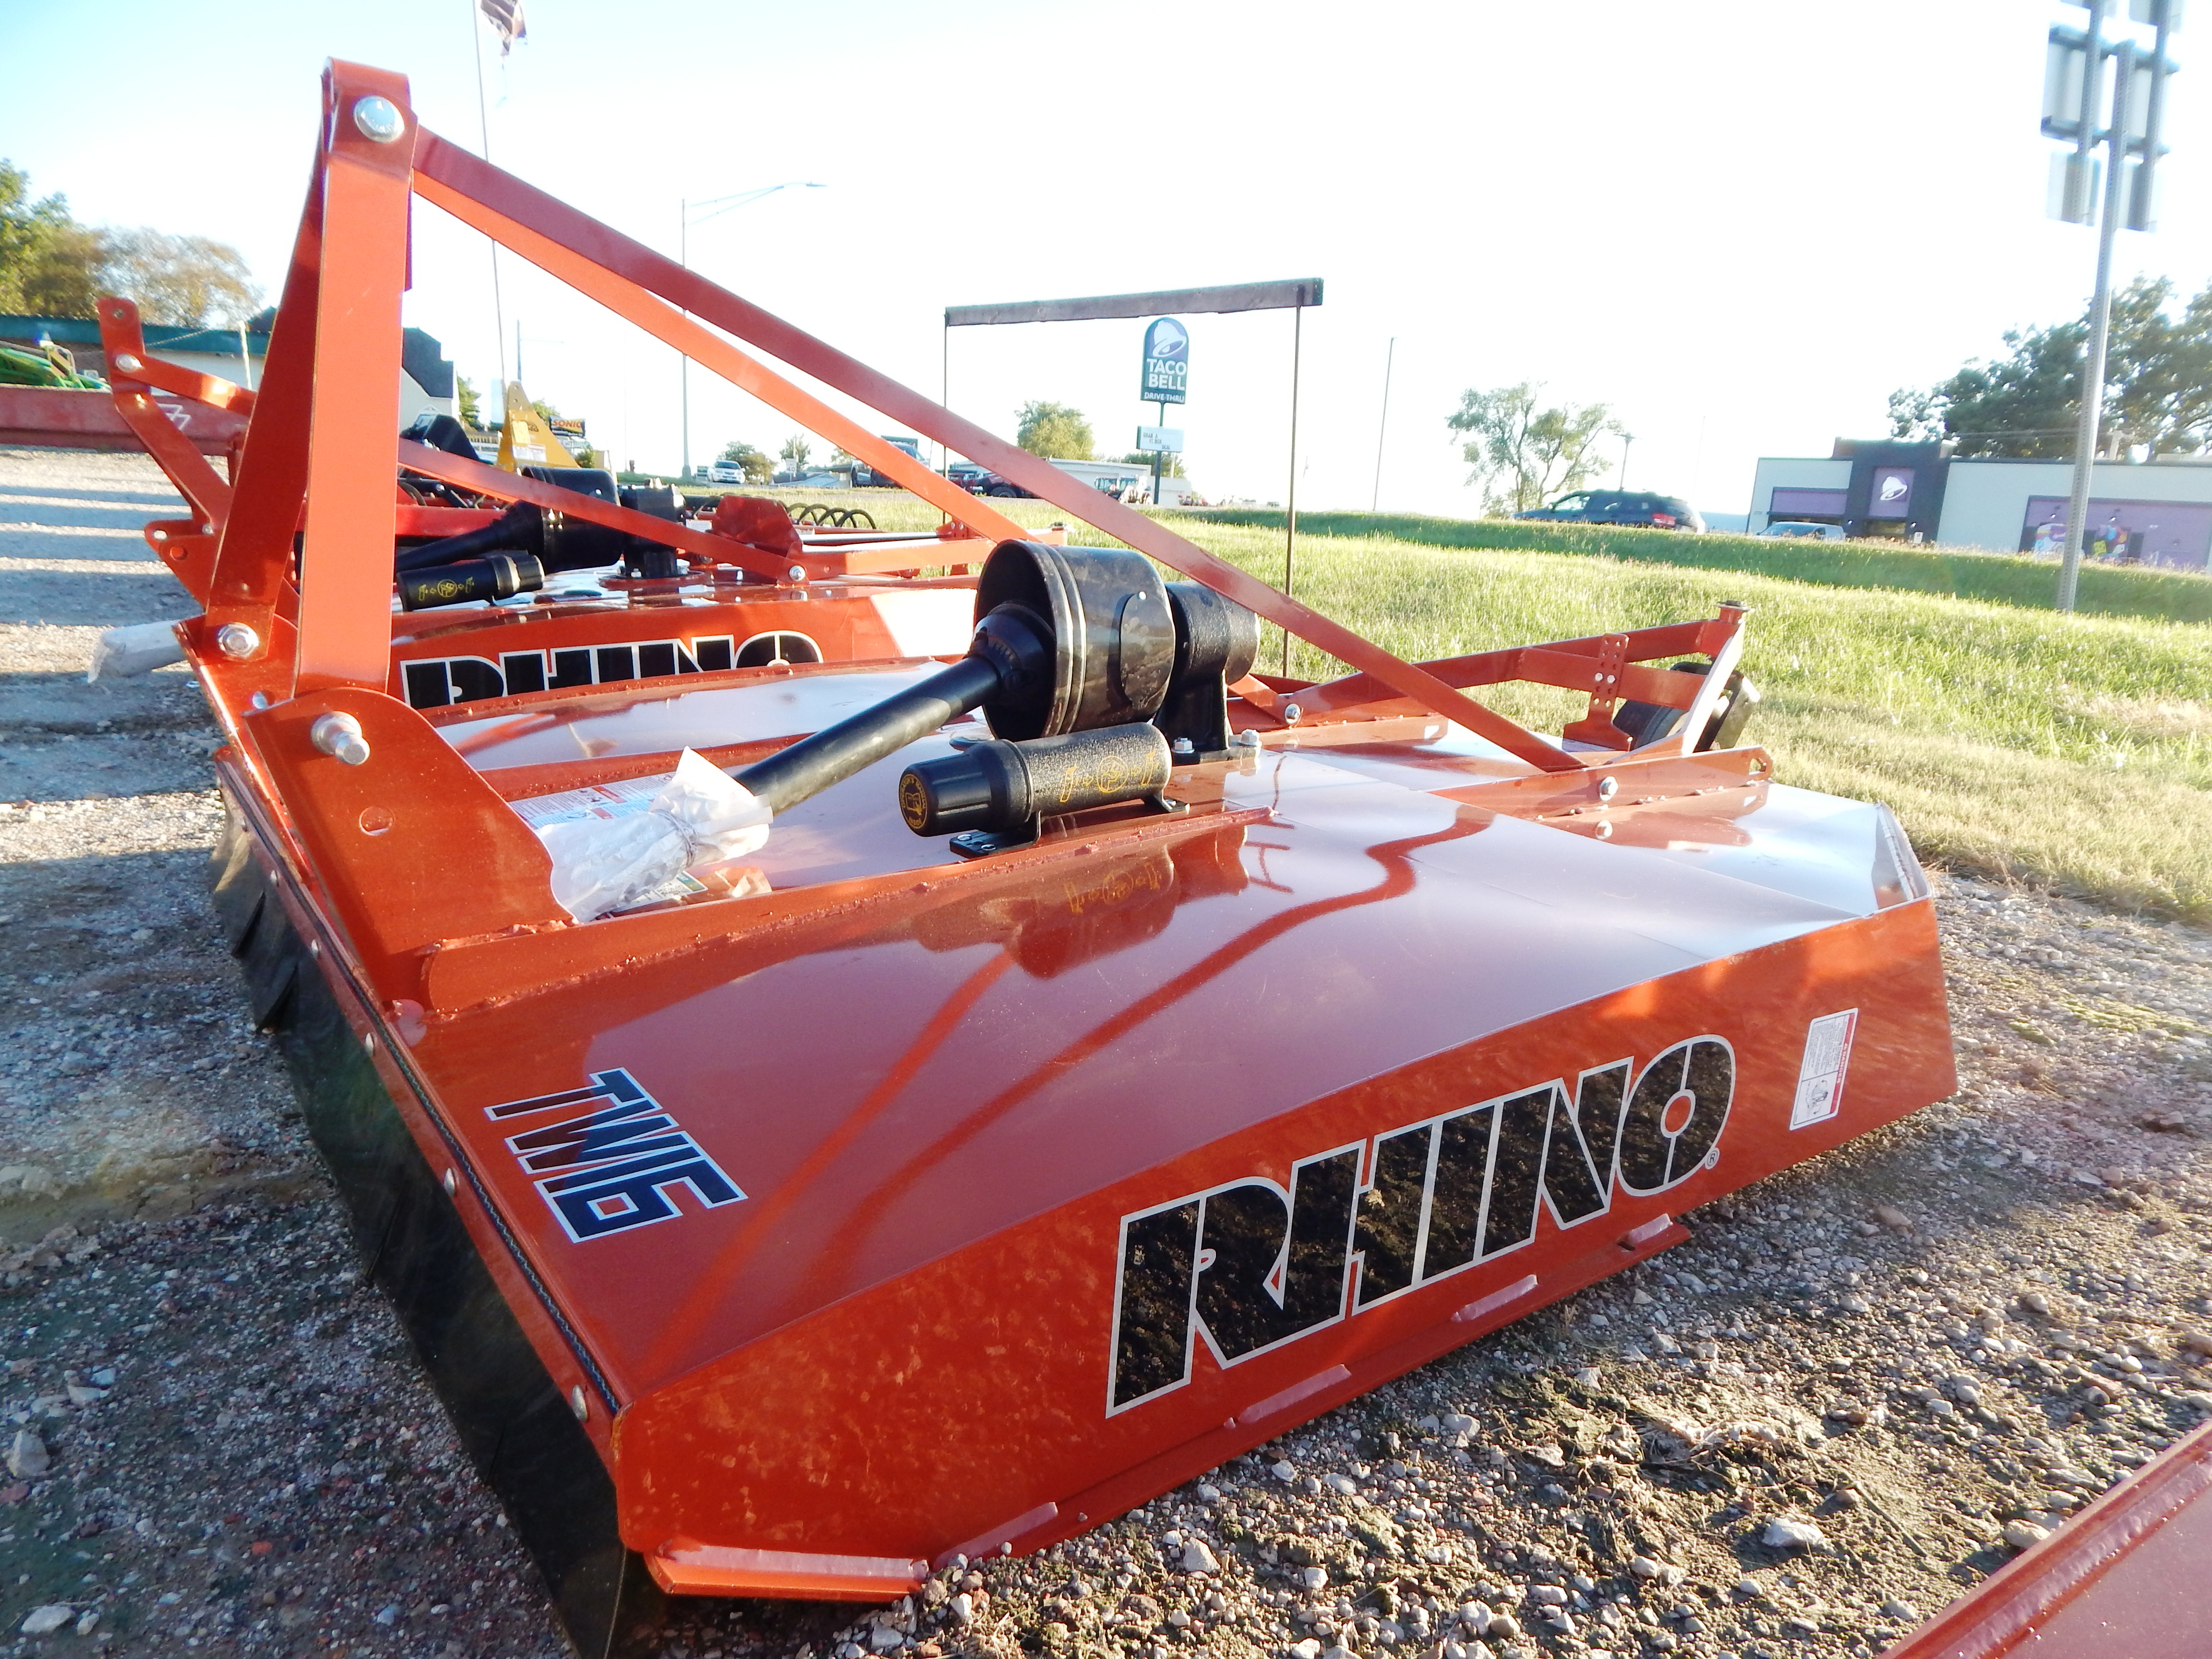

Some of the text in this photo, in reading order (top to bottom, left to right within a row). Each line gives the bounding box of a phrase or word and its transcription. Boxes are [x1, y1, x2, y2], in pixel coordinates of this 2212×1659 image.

[1146, 358, 1187, 375] TACO
[1149, 373, 1185, 390] BELL
[1144, 392, 1184, 402] DRIVE THRU
[553, 419, 581, 428] SONIC
[1837, 1050, 1846, 1083] DANGER
[483, 1067, 749, 1244] TW16
[1106, 1034, 1736, 1418] RHINO
